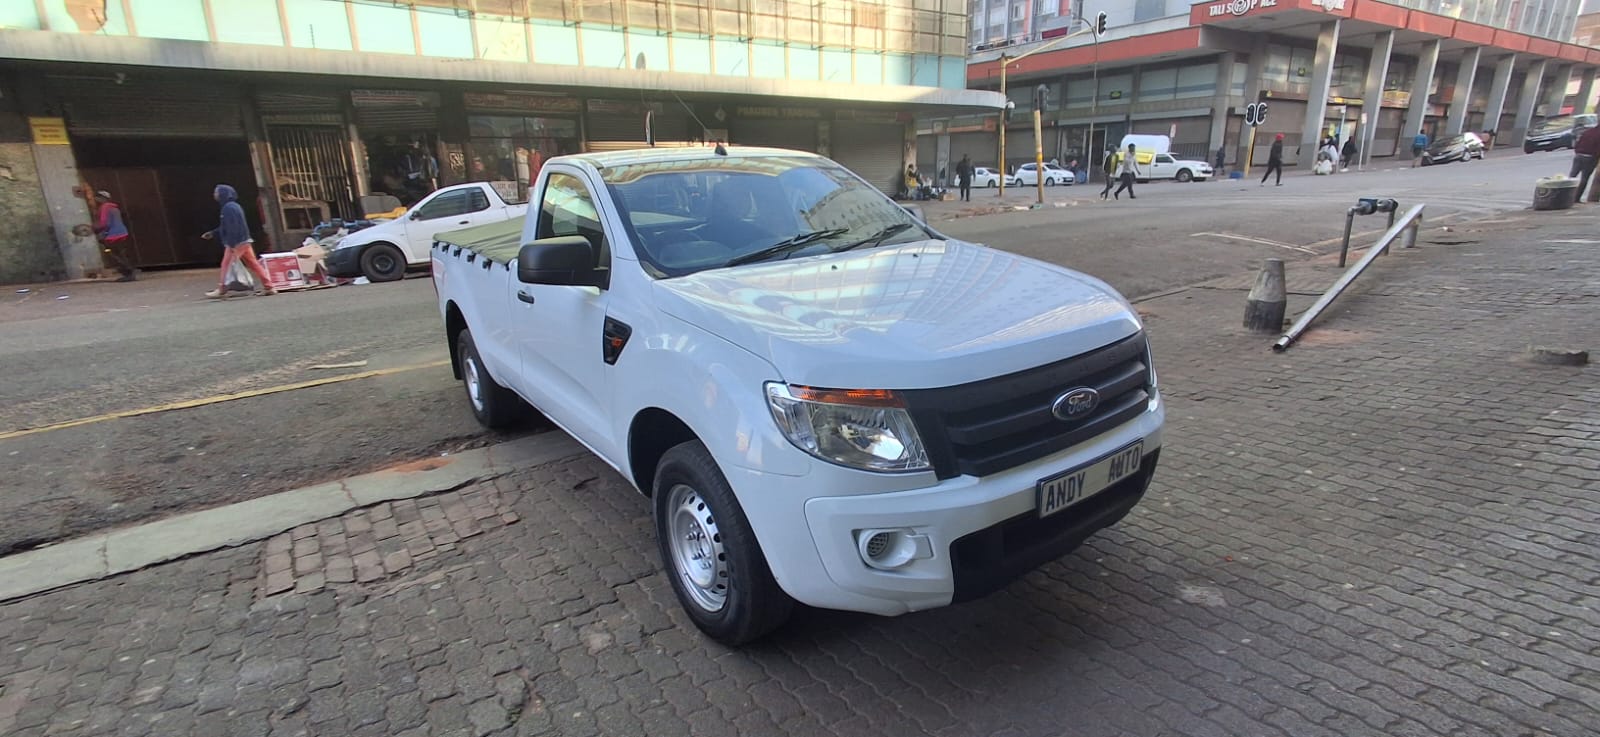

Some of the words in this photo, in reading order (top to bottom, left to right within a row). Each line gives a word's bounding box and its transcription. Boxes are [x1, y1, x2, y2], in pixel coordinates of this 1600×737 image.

[1067, 393, 1092, 415] Ford
[1045, 471, 1086, 513] ANDY
[1108, 446, 1139, 483] AUTO
